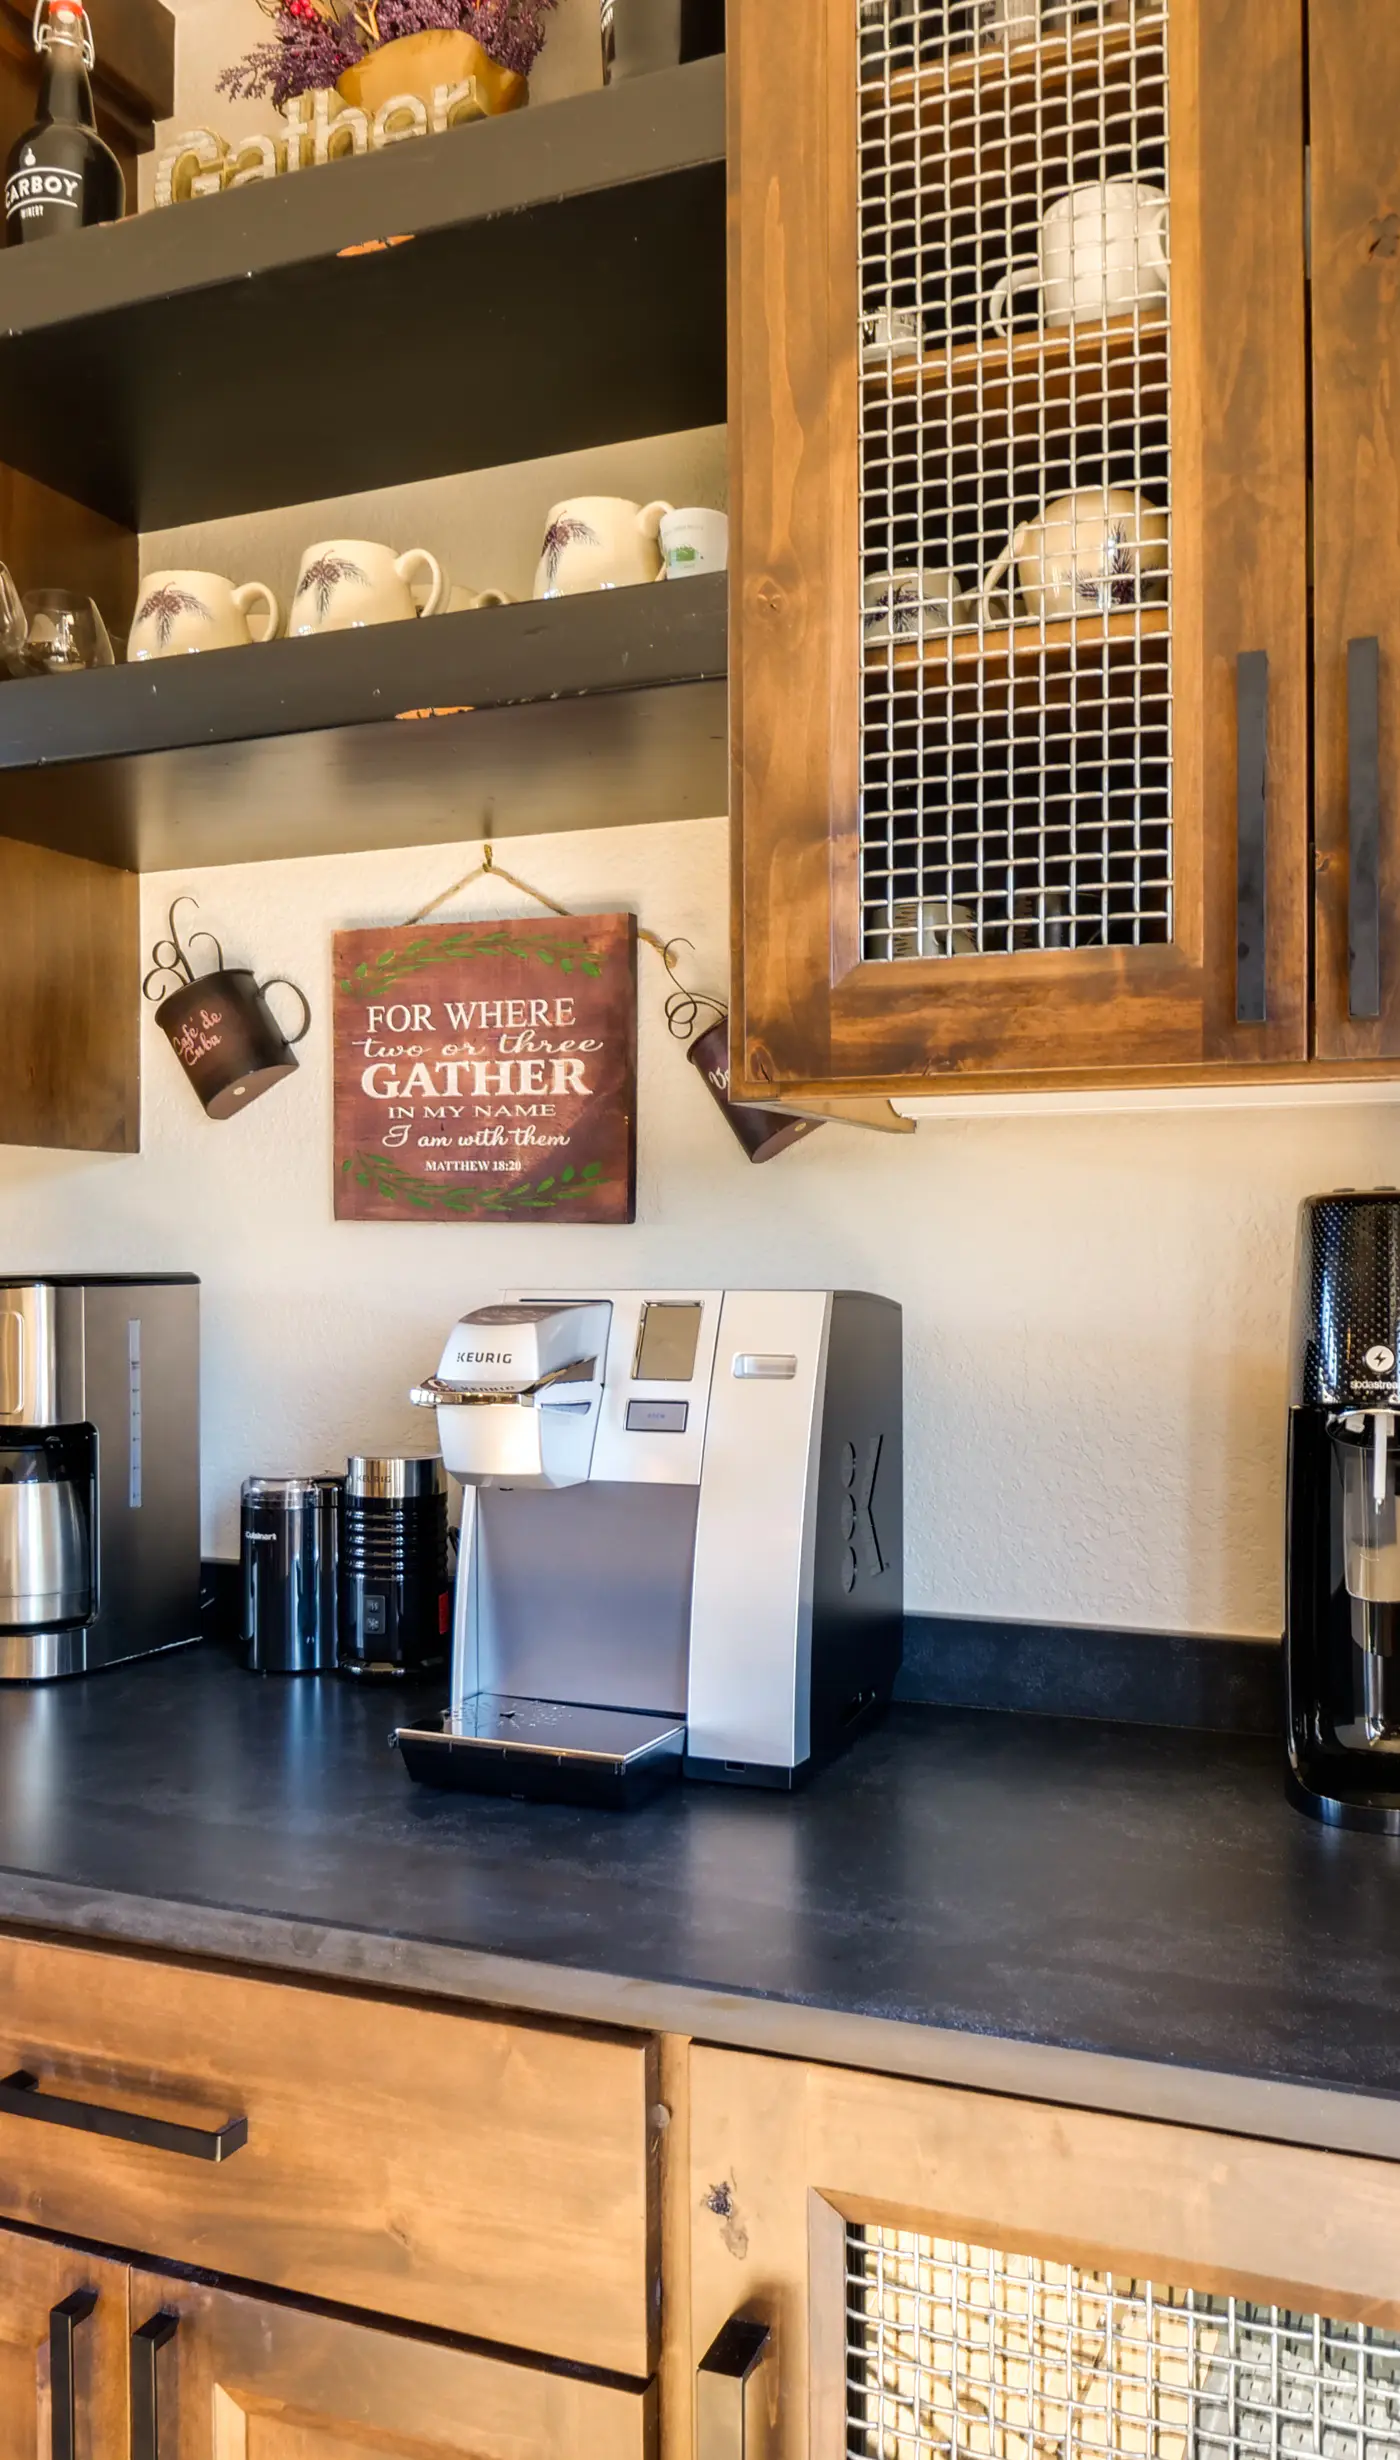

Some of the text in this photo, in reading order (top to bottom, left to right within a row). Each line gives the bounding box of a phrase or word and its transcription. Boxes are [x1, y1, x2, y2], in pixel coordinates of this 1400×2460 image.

[154, 77, 471, 206] Gather
[5, 175, 78, 209] CARBOY
[200, 1009, 223, 1030] de
[366, 997, 576, 1033] FOR WHERE
[184, 1031, 223, 1067] Cuba
[352, 1029, 604, 1058] two or three
[361, 1058, 593, 1099] GATHER
[388, 1103, 557, 1119] IN MY NAME
[382, 1124, 571, 1148] I am with them
[424, 1160, 522, 1172] MATTHEW 18:20
[456, 1351, 513, 1364] KEURIG
